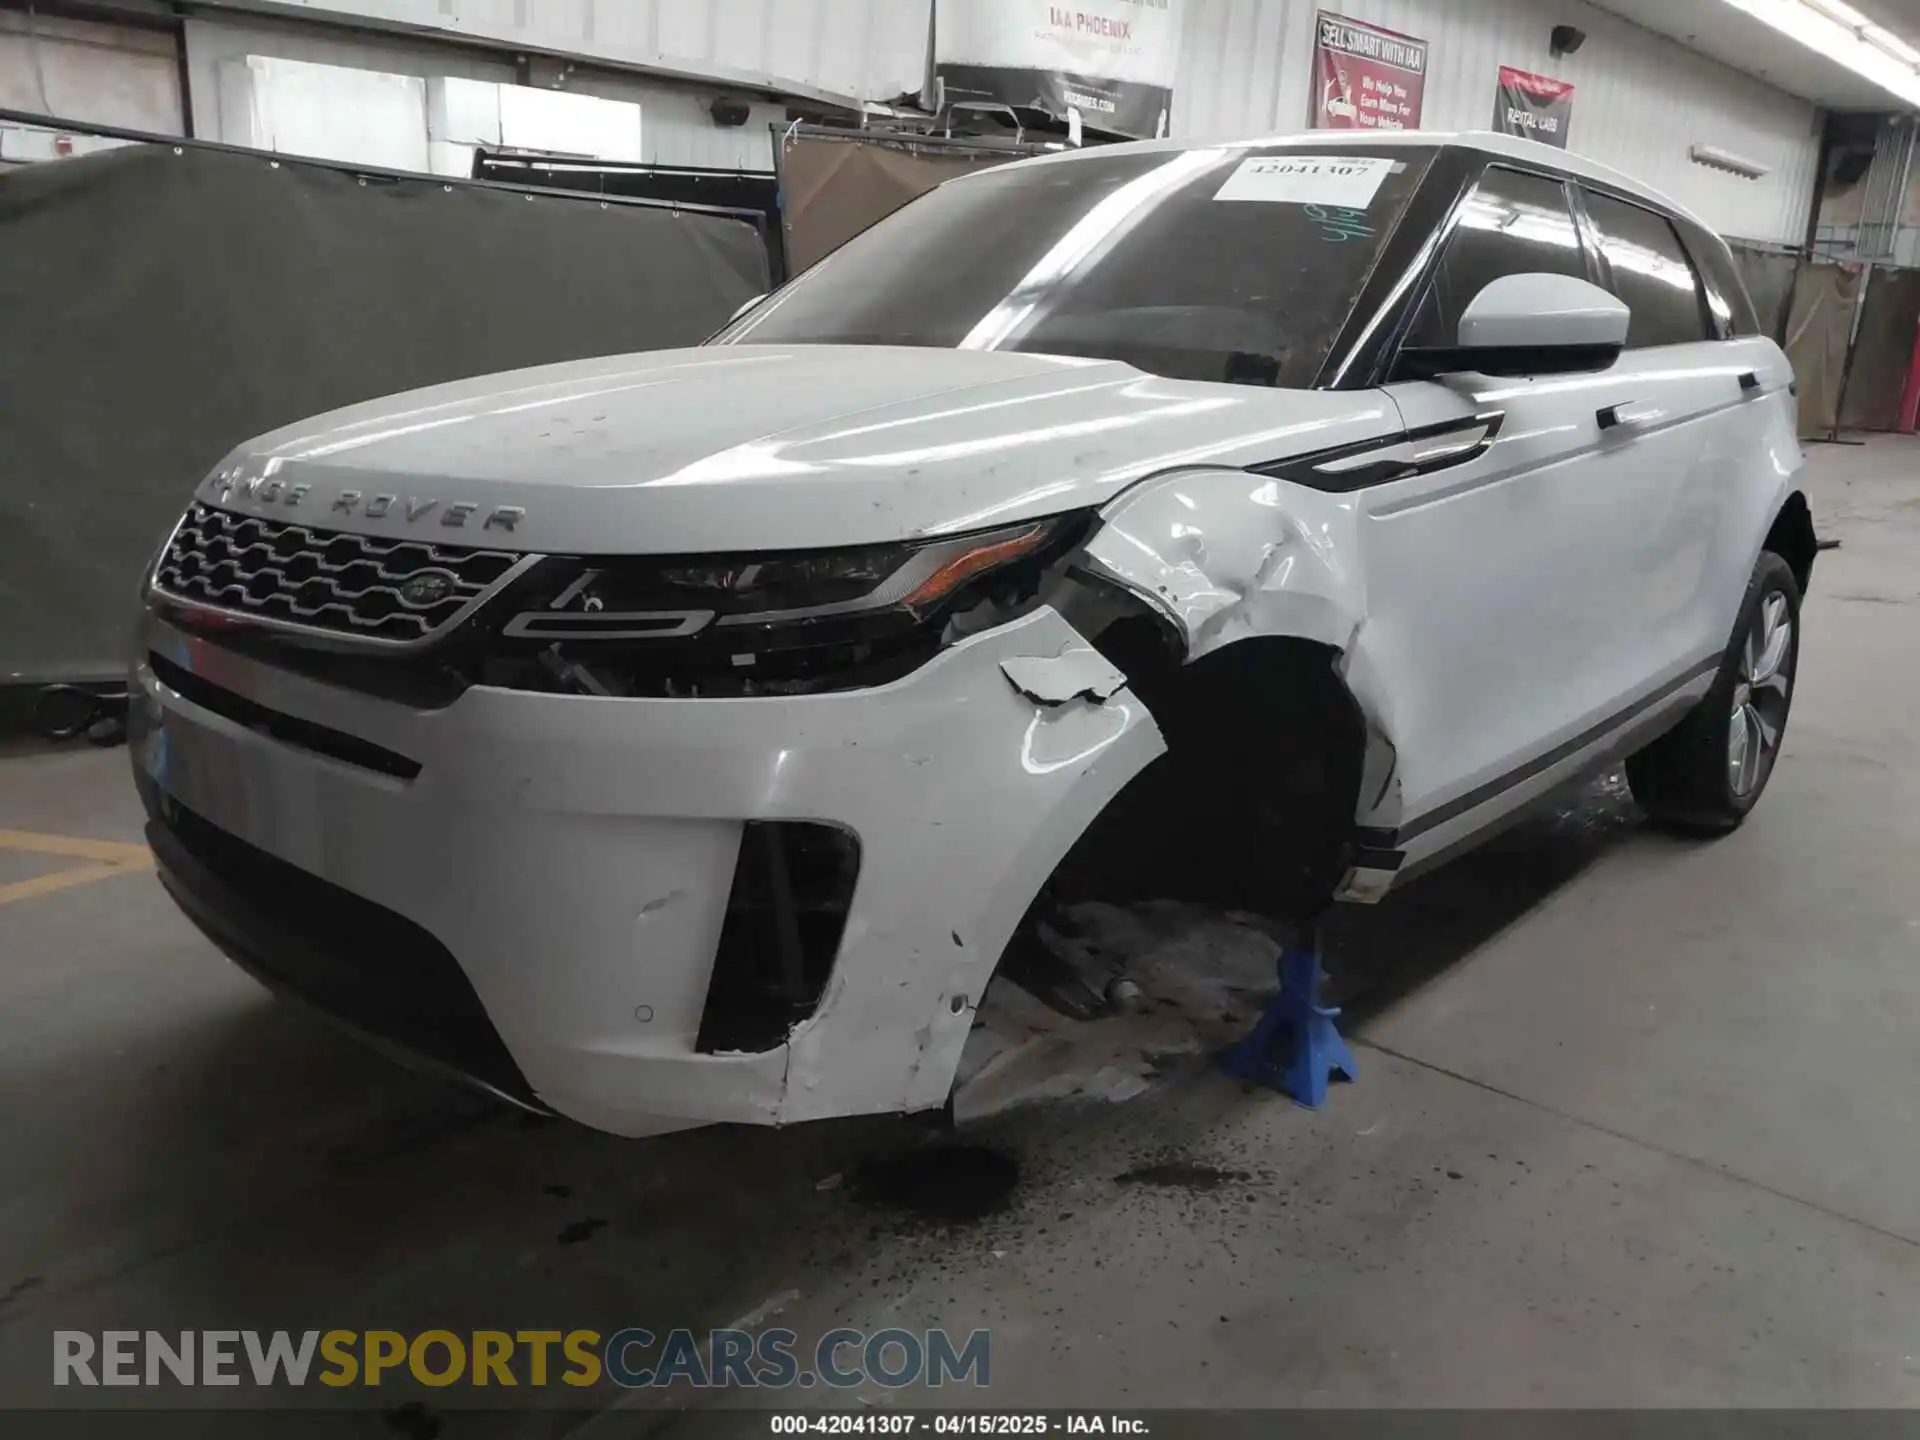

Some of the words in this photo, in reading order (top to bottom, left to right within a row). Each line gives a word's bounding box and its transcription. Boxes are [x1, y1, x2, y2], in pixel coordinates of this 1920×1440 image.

[1048, 6, 1072, 29] IAA
[1076, 12, 1131, 40] PHOENIX
[1322, 23, 1346, 49] SELL
[1346, 30, 1381, 58] SMART
[1381, 39, 1405, 64] WITH
[1406, 46, 1421, 69] IAA
[1360, 93, 1378, 108] Earn
[1376, 79, 1393, 97] Help
[1507, 107, 1537, 129] RENTAL
[1538, 117, 1558, 133] CARS
[332, 489, 526, 533] ROVER
